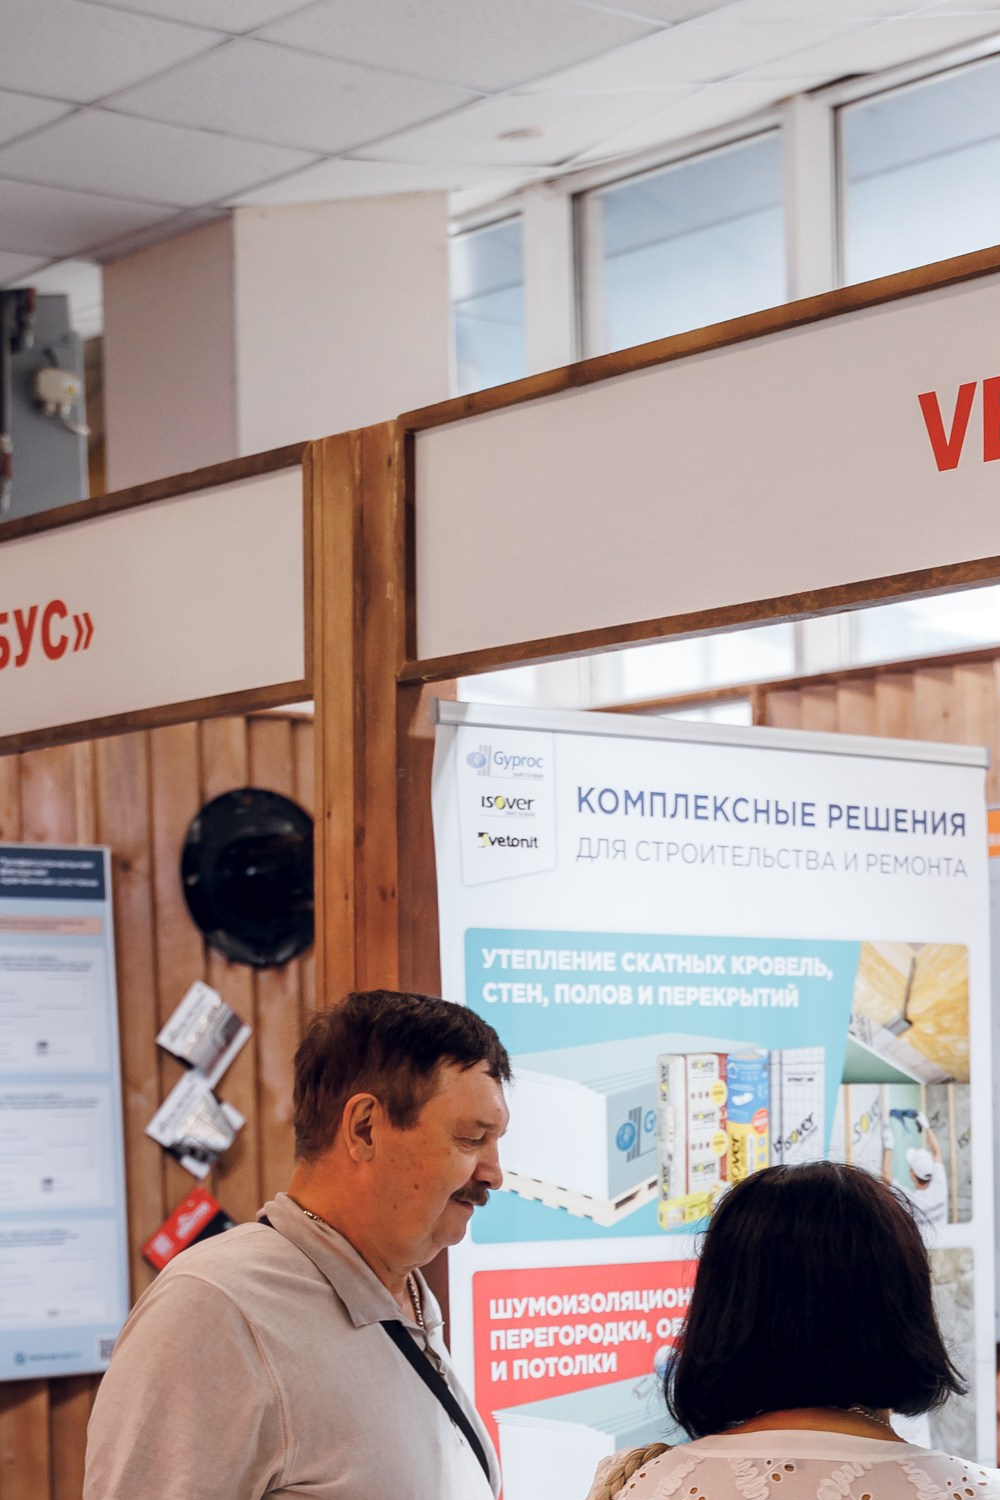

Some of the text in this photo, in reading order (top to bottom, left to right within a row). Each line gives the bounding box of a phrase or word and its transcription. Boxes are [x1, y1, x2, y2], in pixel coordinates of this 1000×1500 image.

[493, 750, 544, 771] Gyproc
[576, 786, 967, 837] КОМПЛЕКСНЫЕ РЕШЕНИЯ
[576, 837, 969, 879] ДЛЯ СТРОИТЕЛЬСТВА И РЕМОНТА
[481, 947, 834, 981] УТЕПЛЕНИЕ СКАТНЫХ КРОВЕЛЬ,
[482, 981, 801, 1008] СТЕН, ПОЛОВ И ПЕРЕКРЫТИЙ
[489, 1286, 695, 1321] ШУМОИЗОЛЯЦИОН
[490, 1320, 653, 1352] ПЕРЕГОРОДКИ,
[491, 1352, 618, 1383] И ПОТОЛКИ
